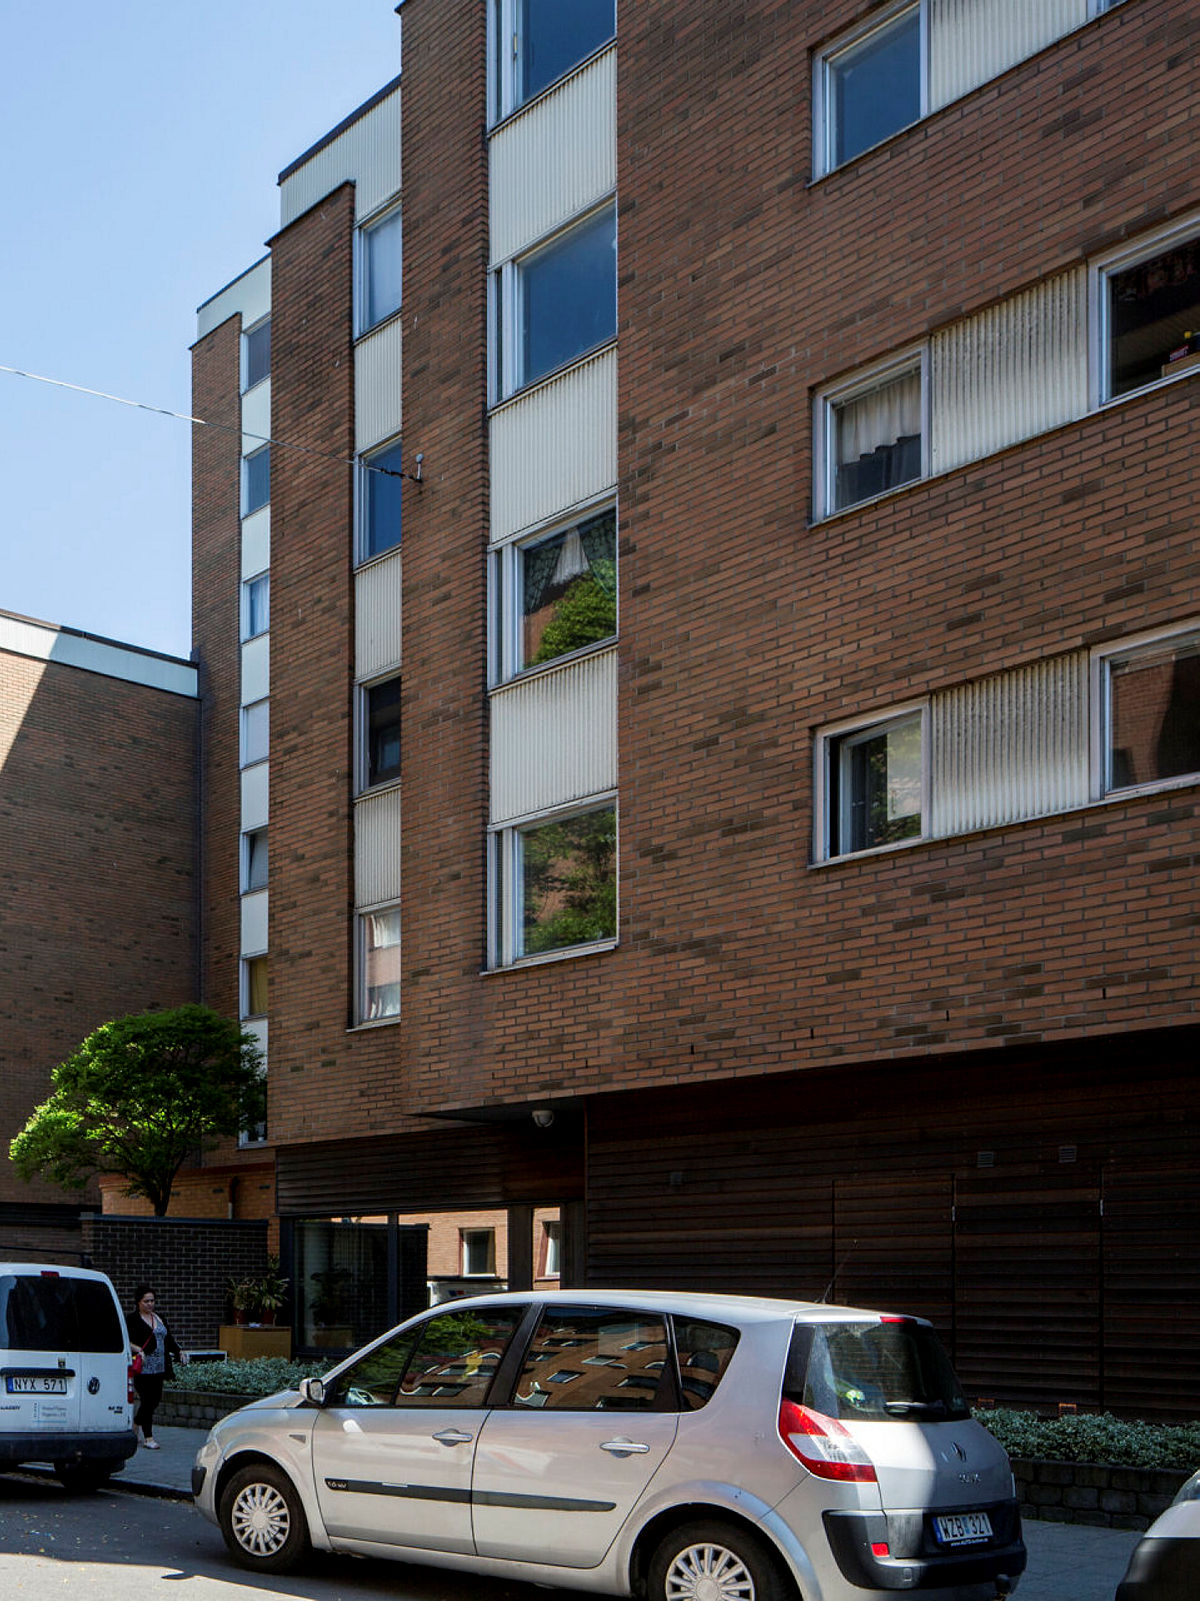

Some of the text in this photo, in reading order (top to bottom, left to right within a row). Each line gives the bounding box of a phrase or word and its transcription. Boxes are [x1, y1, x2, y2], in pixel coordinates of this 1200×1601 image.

[14, 1378, 64, 1391] NYX 571
[939, 1514, 990, 1538] WZB 321
